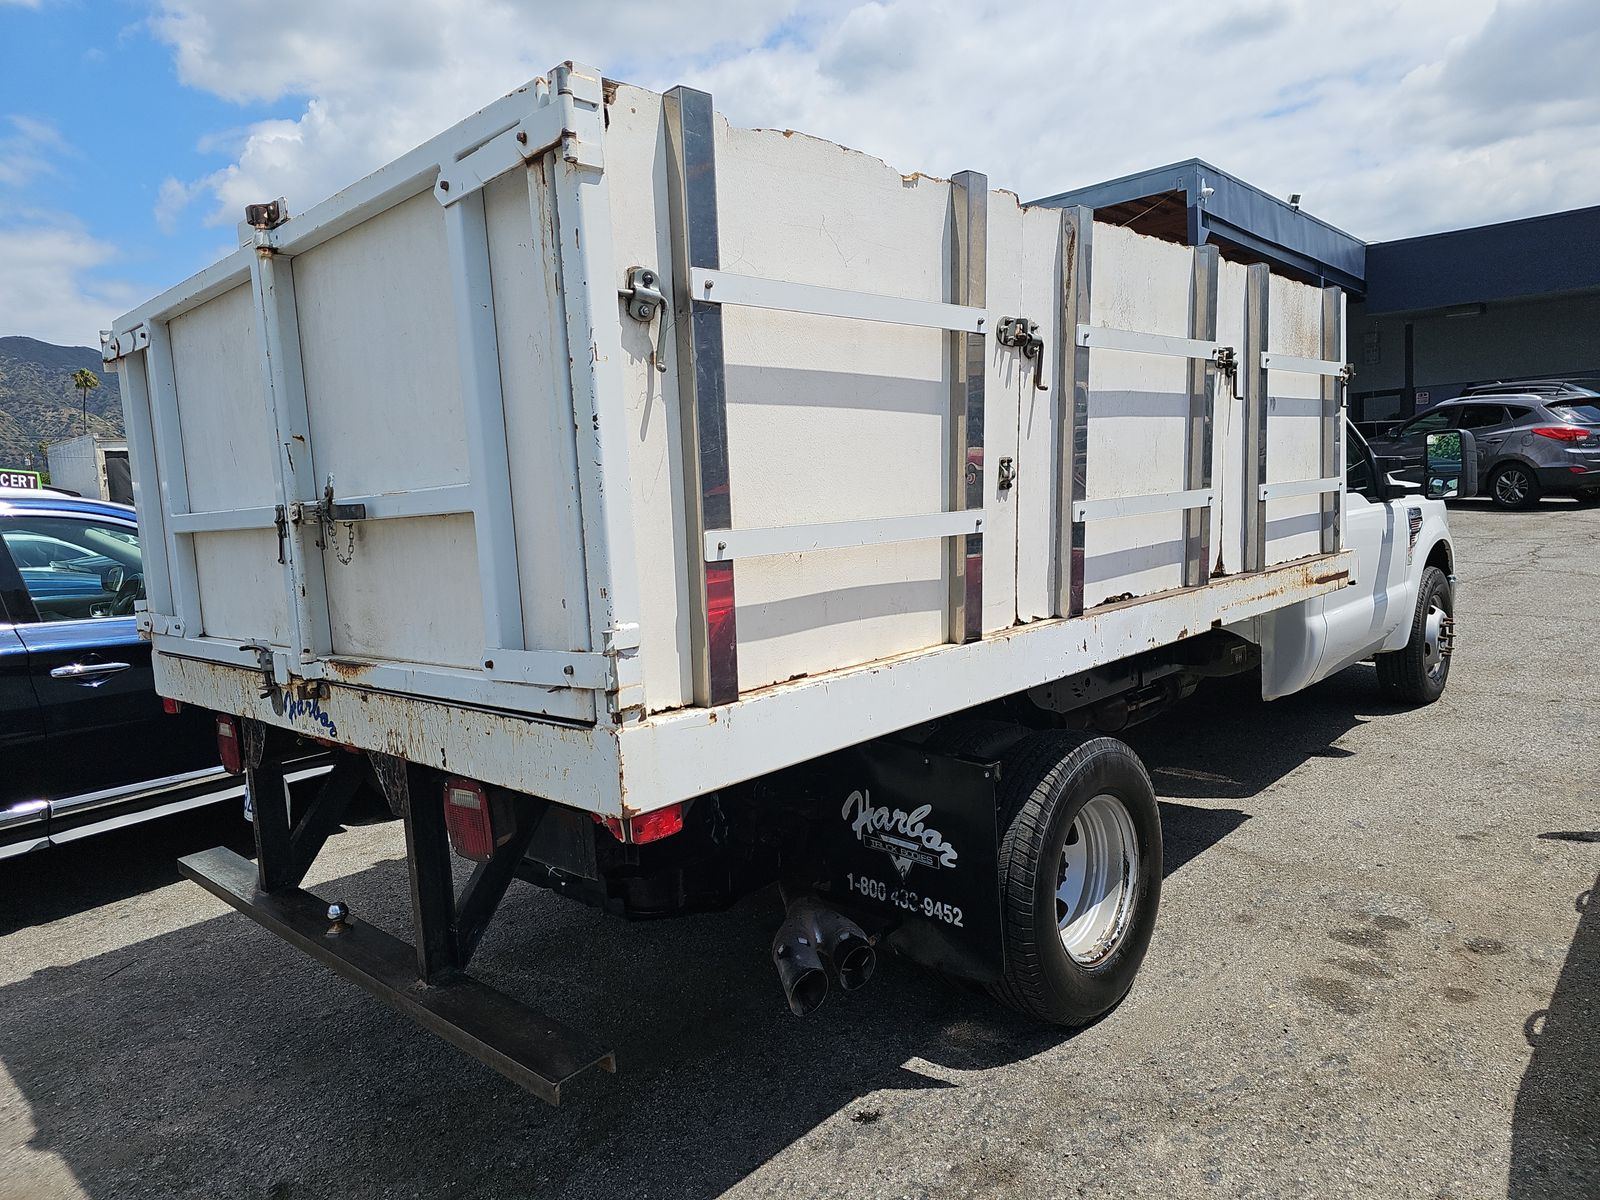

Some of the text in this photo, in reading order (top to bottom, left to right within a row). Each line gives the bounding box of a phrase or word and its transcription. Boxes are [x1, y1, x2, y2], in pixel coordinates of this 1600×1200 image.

[0, 473, 36, 489] CERT
[841, 789, 959, 868] Harbor
[899, 848, 934, 866] BODIES
[846, 872, 964, 928] 1-800 433-9452
